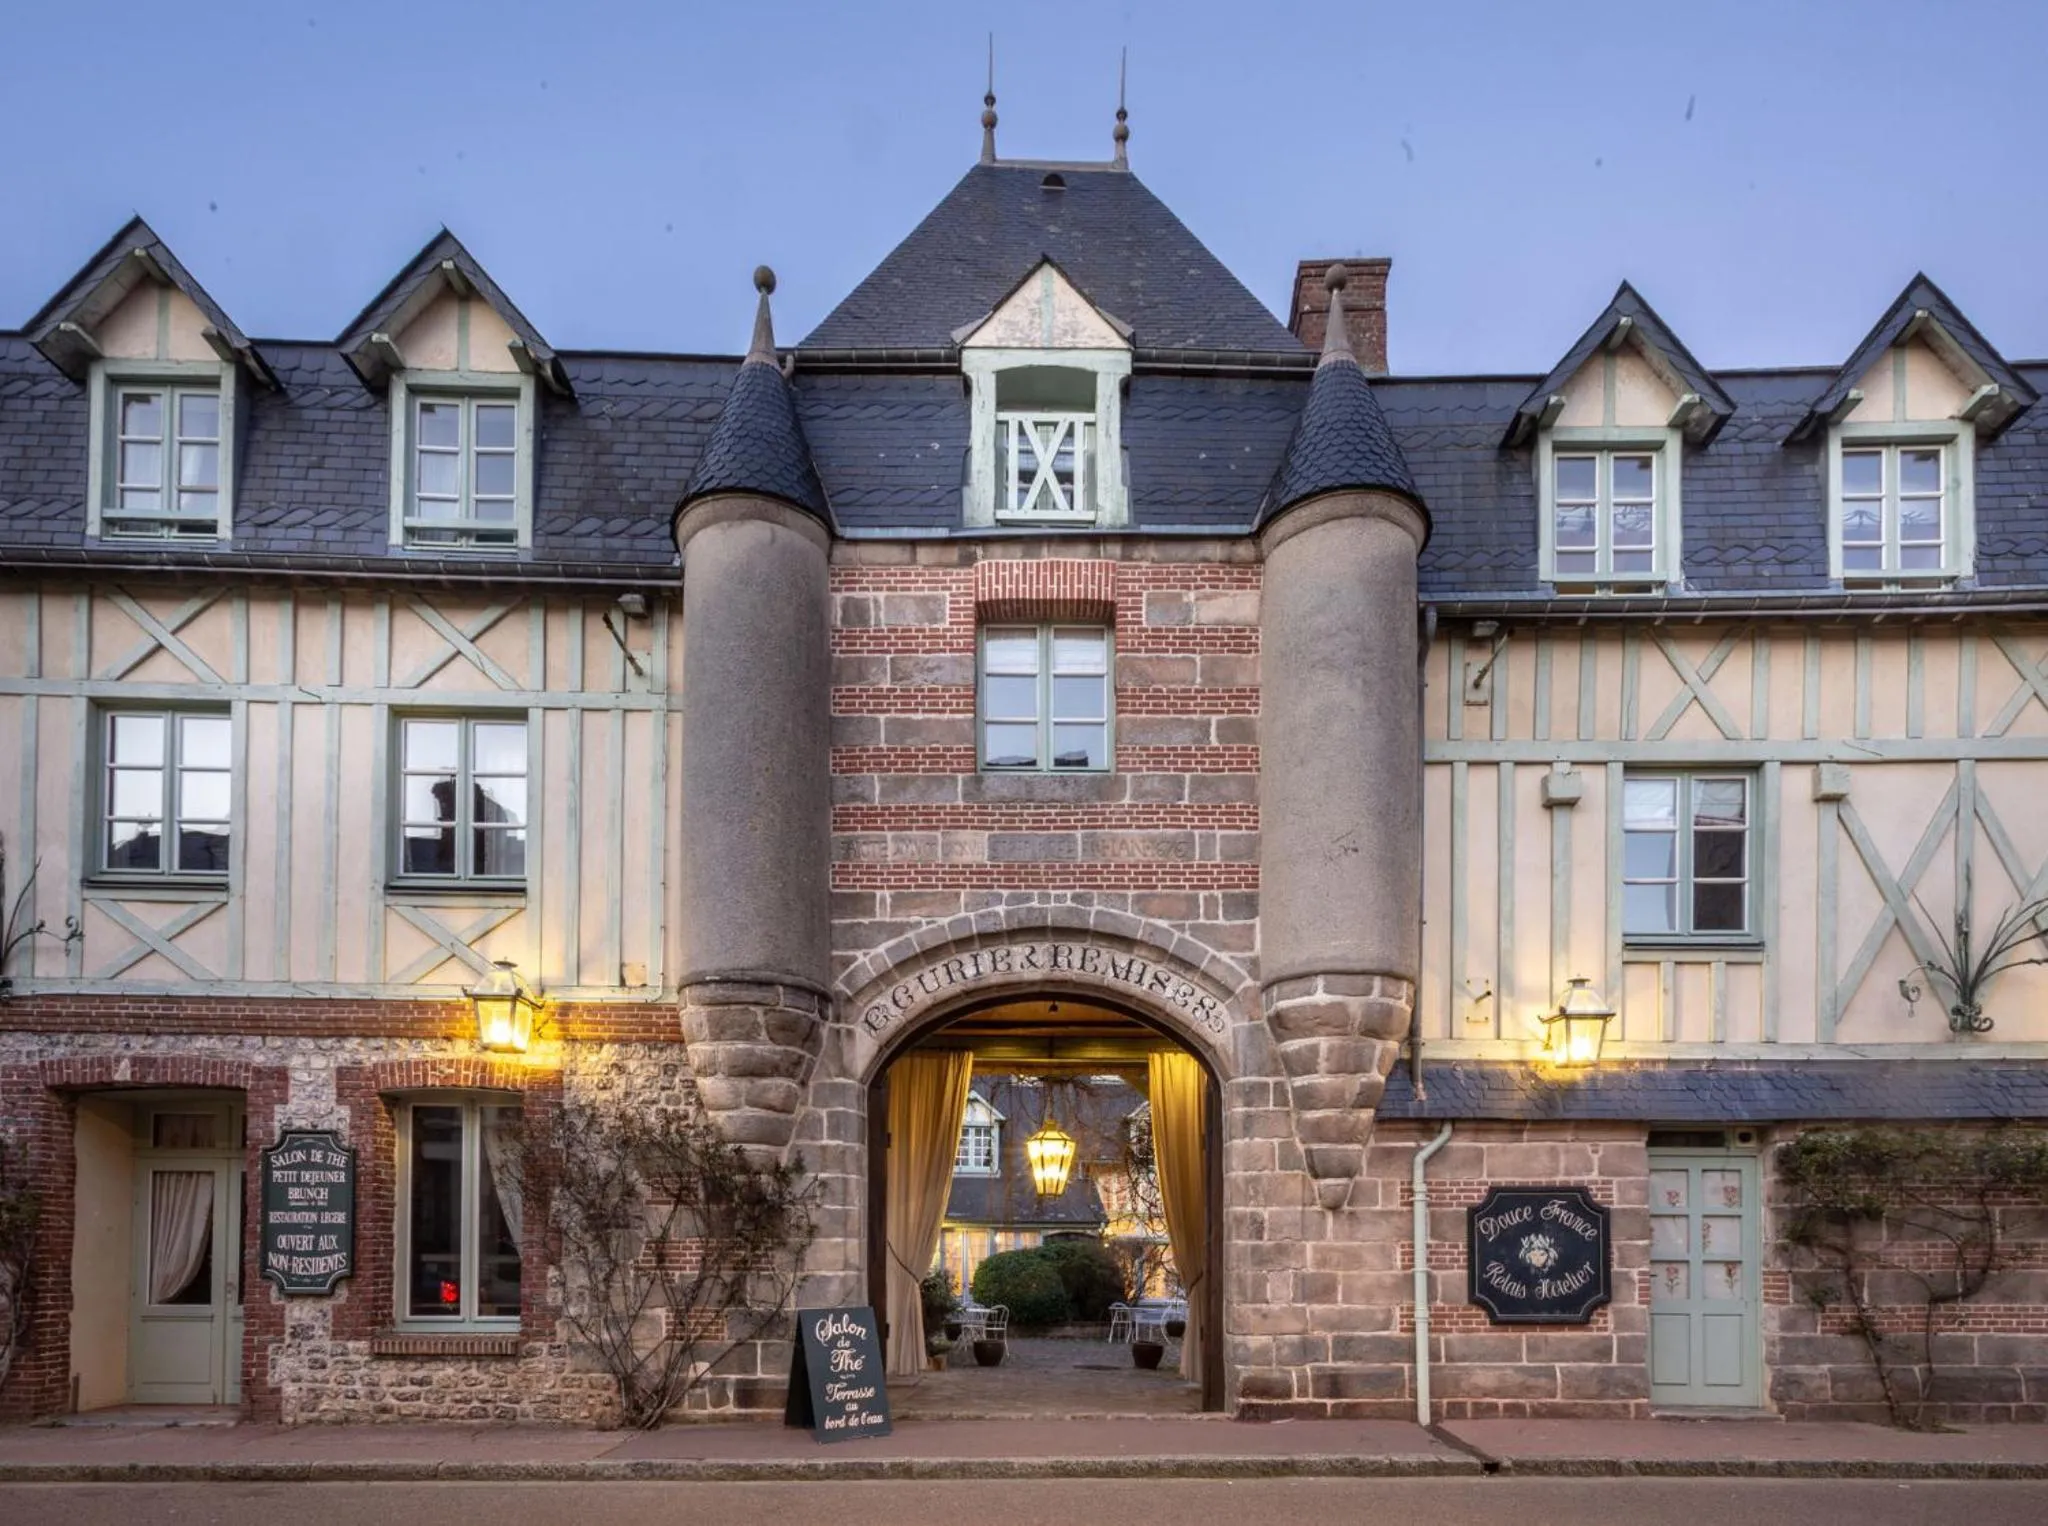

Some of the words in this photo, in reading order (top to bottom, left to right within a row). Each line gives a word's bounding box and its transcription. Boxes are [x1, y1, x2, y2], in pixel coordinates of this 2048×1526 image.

[270, 1149, 307, 1168] SALON
[310, 1149, 325, 1163] DE
[327, 1151, 348, 1168] THE
[272, 1170, 297, 1183] PETIT
[300, 1170, 346, 1185] DEJEUNER
[287, 1187, 328, 1200] BRUNCH
[269, 1211, 318, 1224] RESTAURATION
[1479, 1205, 1534, 1242] Douce
[1540, 1199, 1598, 1241] France
[277, 1234, 315, 1251] OUVERT
[318, 1234, 338, 1250] AUX
[268, 1251, 347, 1276] NON-RESIDENTS
[1483, 1260, 1527, 1299] Relais
[815, 1312, 868, 1347] Salon
[836, 1336, 851, 1347] de
[830, 1349, 867, 1373] Thé
[825, 1382, 876, 1403] Terrasse
[845, 1402, 859, 1412] au
[824, 1413, 846, 1430] bord
[848, 1412, 859, 1426] de
